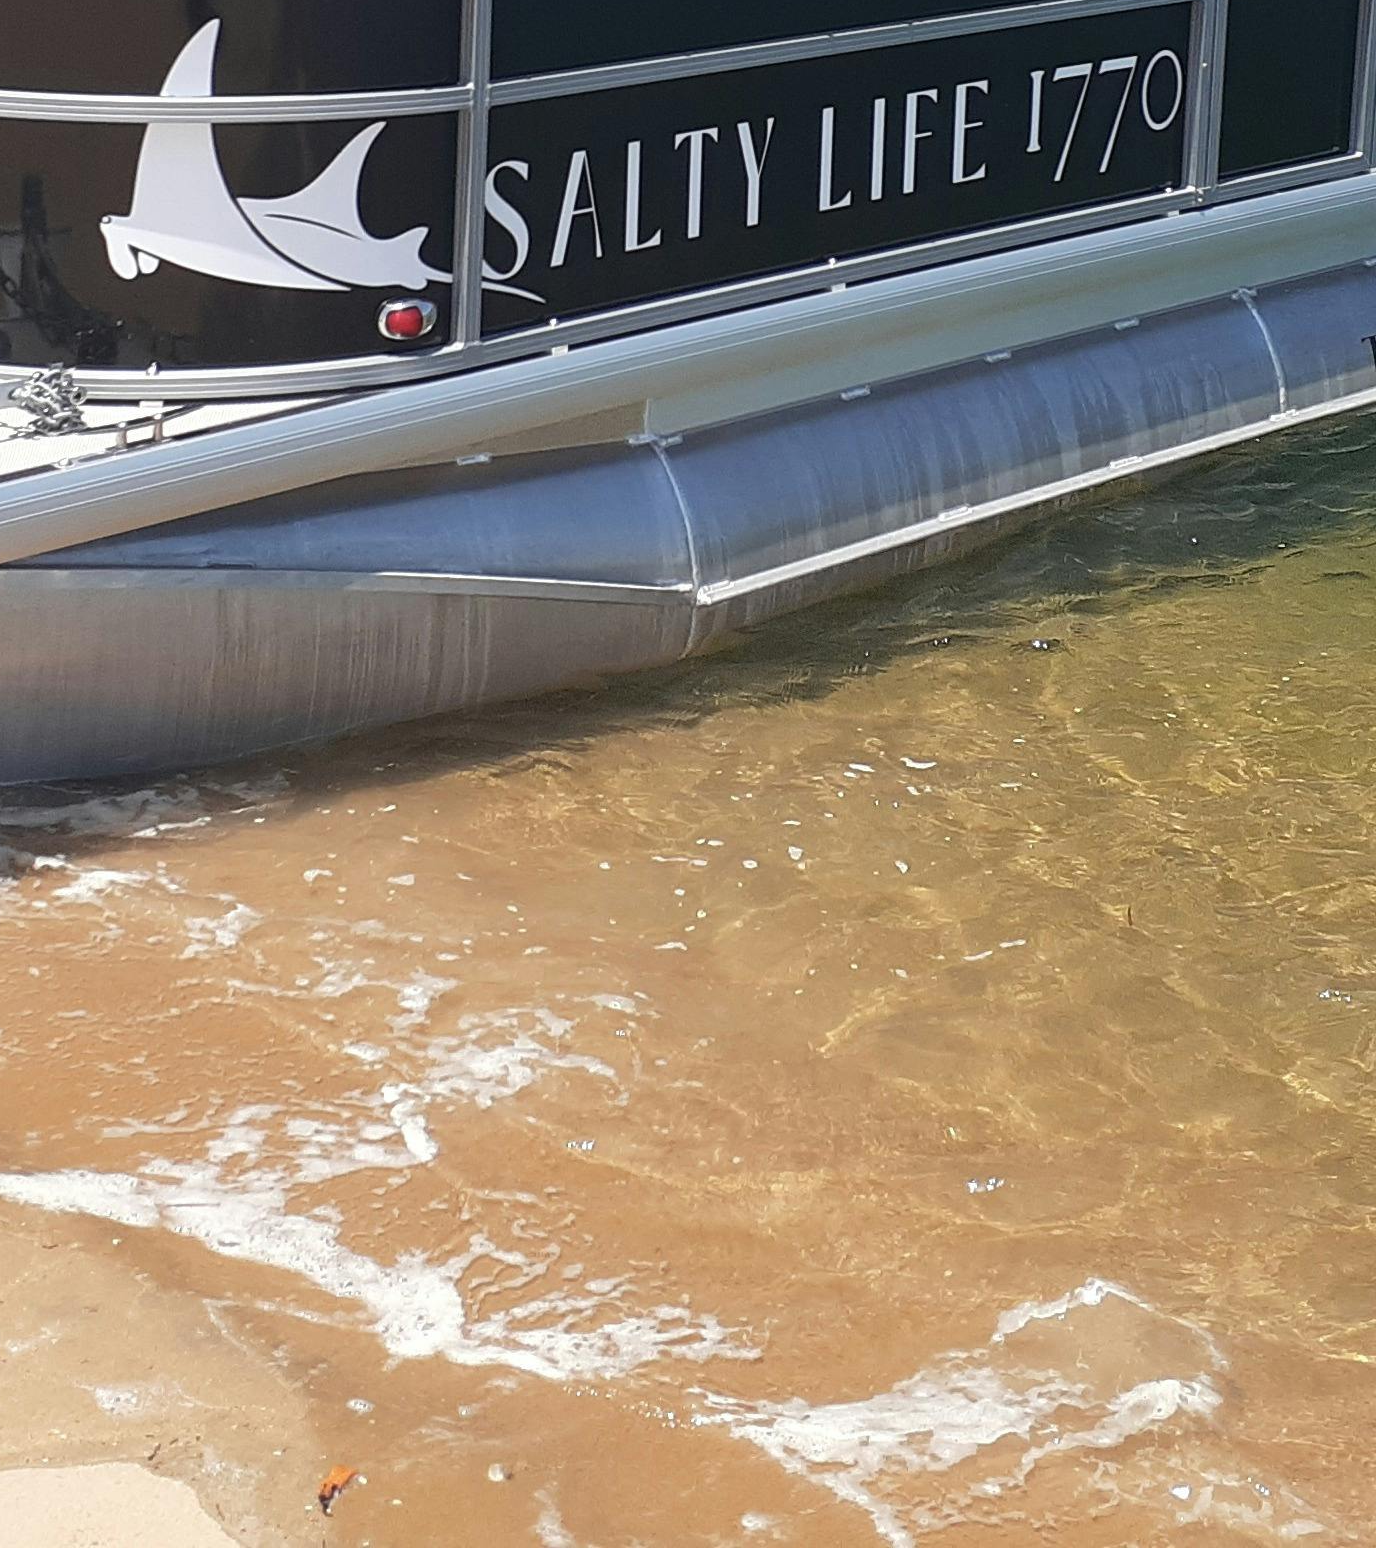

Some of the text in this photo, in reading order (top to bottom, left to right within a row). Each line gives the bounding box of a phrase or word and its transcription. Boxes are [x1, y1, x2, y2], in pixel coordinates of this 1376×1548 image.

[481, 49, 1184, 281] SALTY LIFE 1770
